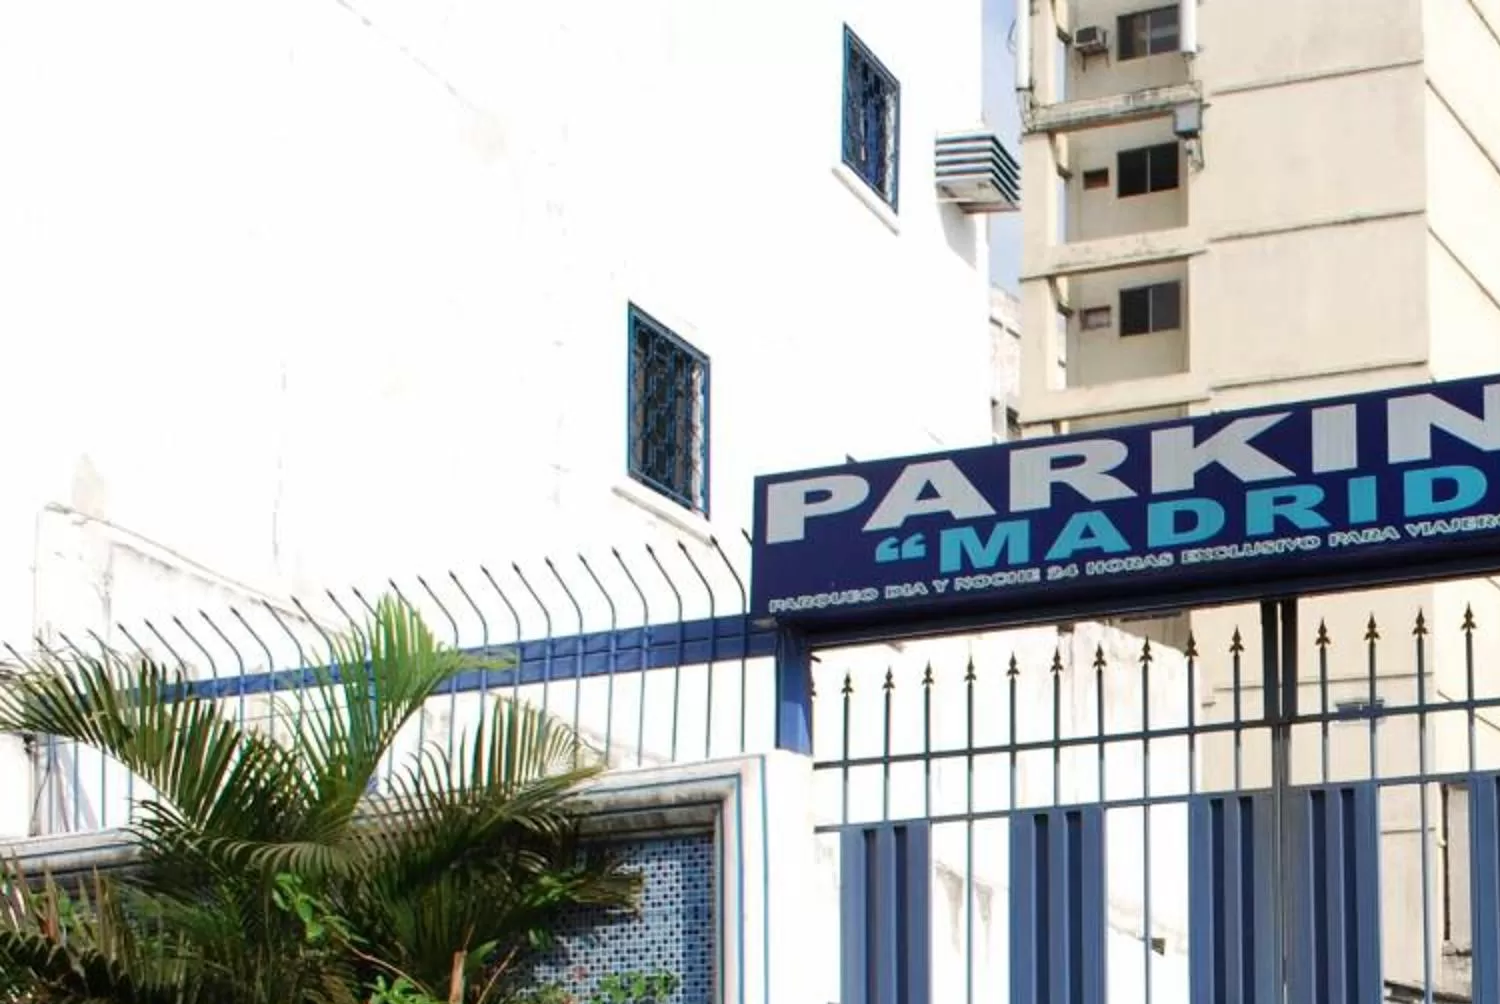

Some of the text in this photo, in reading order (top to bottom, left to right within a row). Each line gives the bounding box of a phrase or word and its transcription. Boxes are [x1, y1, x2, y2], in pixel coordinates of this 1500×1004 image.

[768, 587, 879, 613] PARQUEO
[884, 581, 929, 599] DIA
[932, 579, 950, 593] Y
[953, 567, 1041, 591] NOCHE
[1047, 563, 1079, 580] 24
[1085, 552, 1175, 575] HORAS
[1181, 535, 1321, 565] EXCLUSIVO
[1327, 525, 1401, 547] PARA
